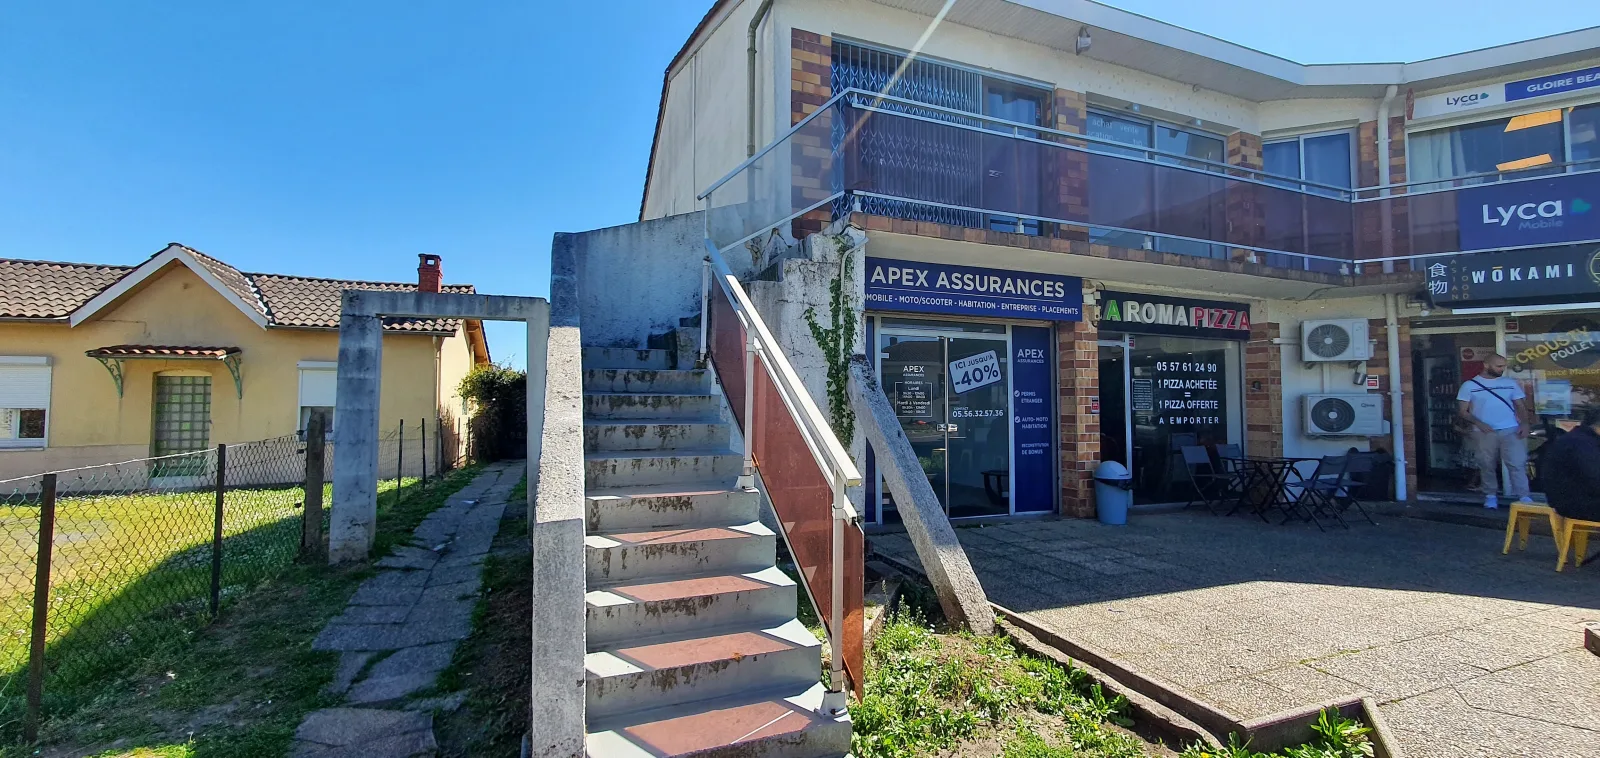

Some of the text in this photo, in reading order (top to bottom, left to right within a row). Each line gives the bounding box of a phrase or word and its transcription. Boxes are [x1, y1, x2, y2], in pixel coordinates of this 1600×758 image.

[1526, 77, 1573, 92] GLOIRE
[1446, 93, 1479, 106] Lyca
[1482, 199, 1563, 226] Lyca
[1518, 219, 1564, 231] Mobile
[870, 265, 1065, 298] APEX ASSURANCES
[1428, 262, 1448, 295] 食物
[1450, 259, 1458, 300] ASIAN
[1461, 267, 1469, 300] FOOD
[899, 295, 953, 306] MOTO/SCOOTER
[958, 299, 996, 310] HABITATION
[1001, 302, 1037, 313] ENTREPRISE
[1041, 305, 1079, 315] PLACEMENTS
[1122, 300, 1189, 327] ROMA
[1189, 306, 1251, 331] PIZZA
[1017, 348, 1044, 359] APEX
[1549, 339, 1596, 362] POULET
[902, 365, 925, 373] APEX
[955, 360, 966, 370] ICI
[1156, 361, 1217, 373] 05 57 61 24 90
[954, 362, 999, 386] -40%
[1157, 378, 1218, 390] 1 PIZZA ACHETÉE
[1158, 400, 1219, 410] 1 PIZZA OFFERTE
[952, 409, 1004, 418] 05.56.32.57.36
[1158, 416, 1220, 425] A EMPORTER
